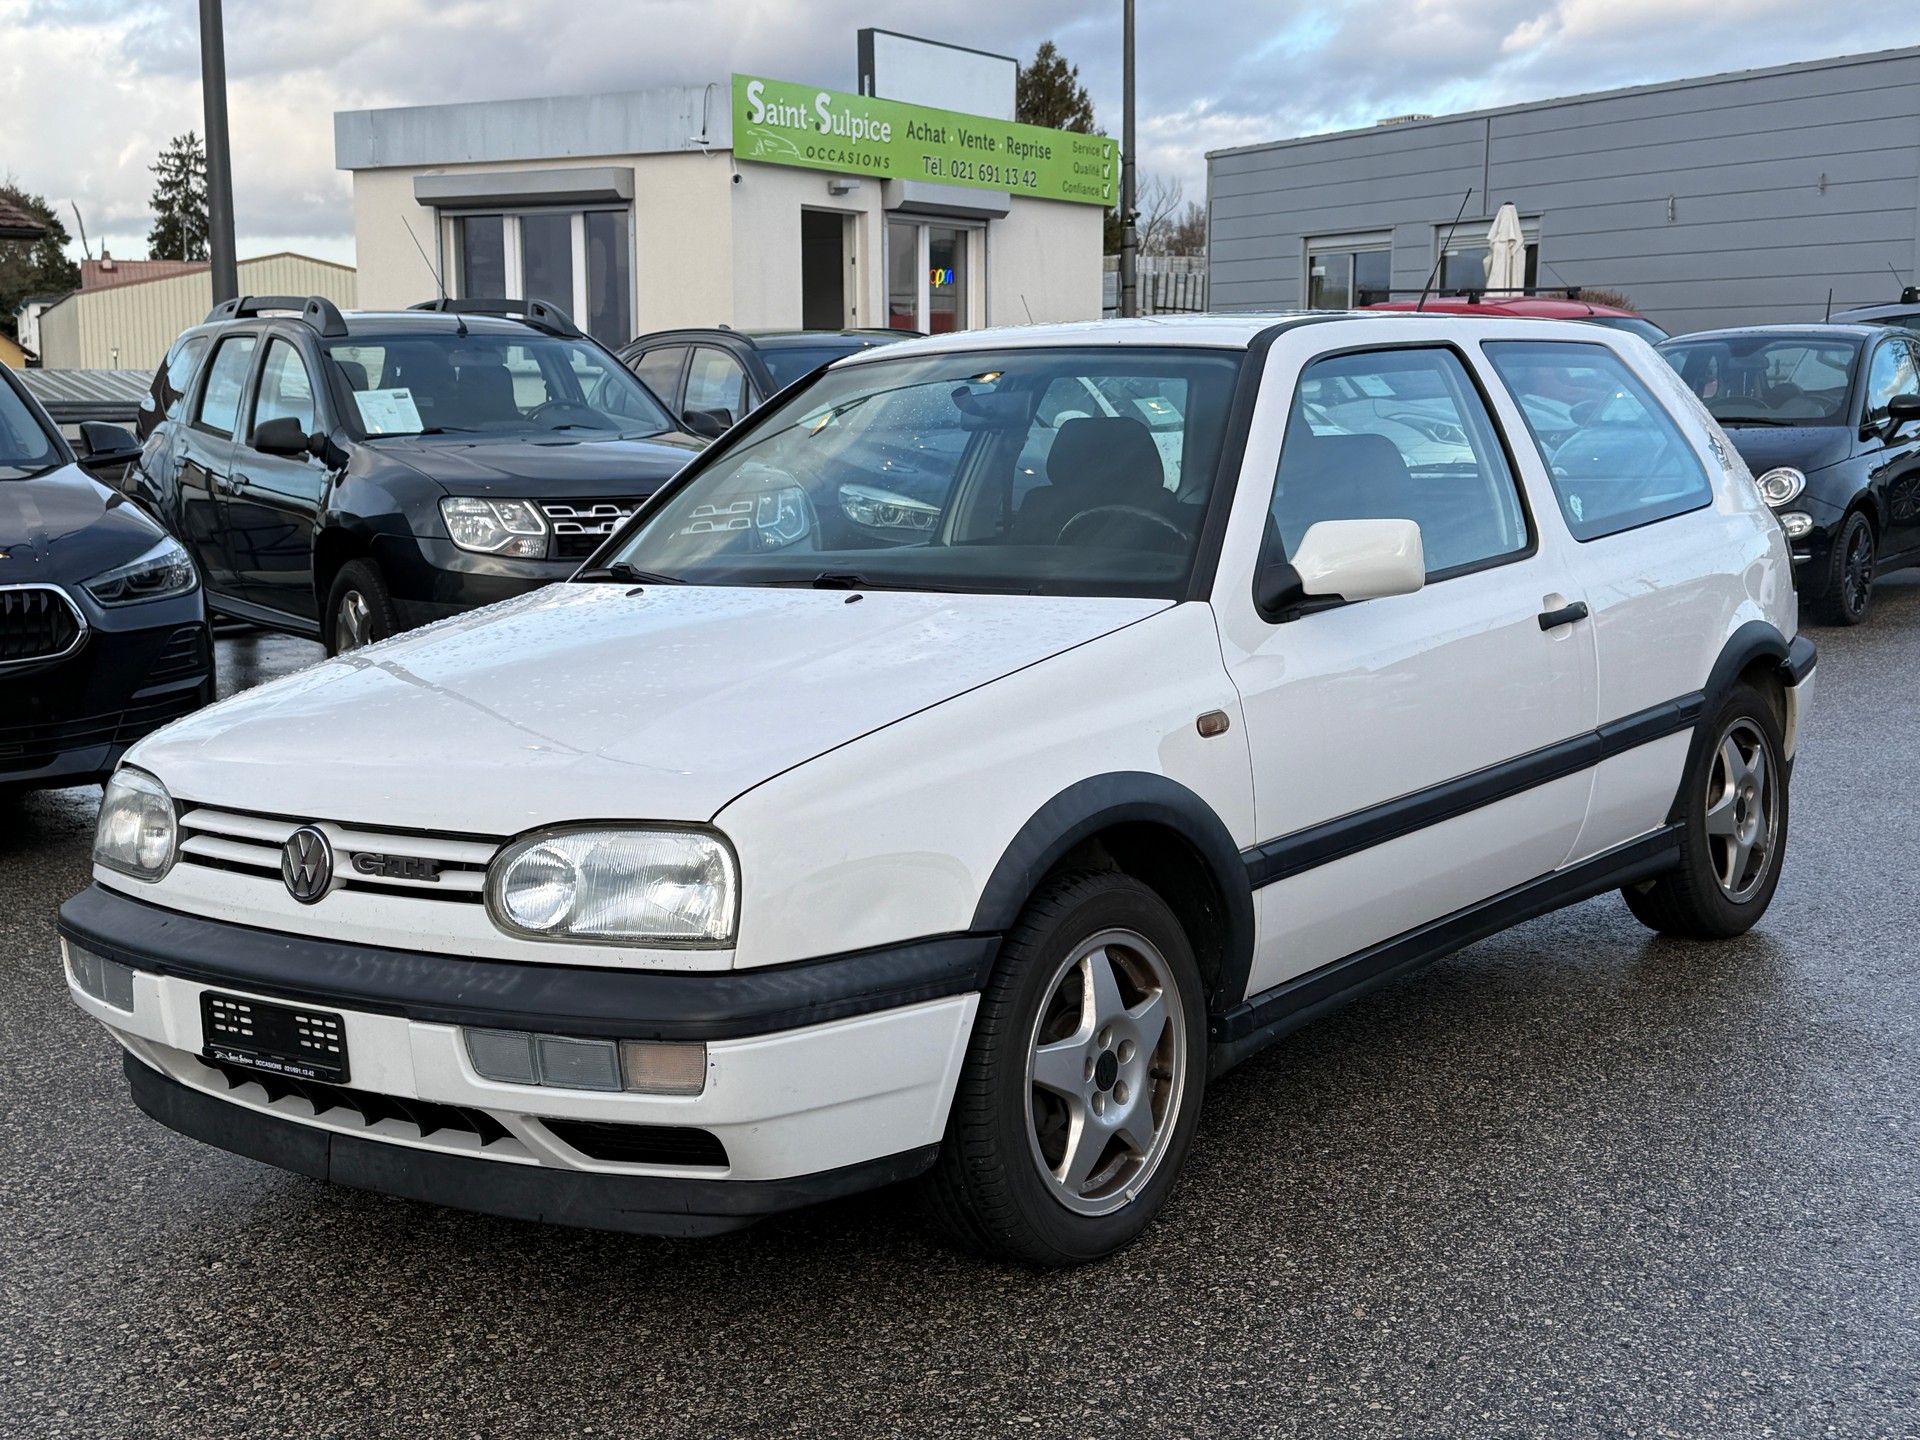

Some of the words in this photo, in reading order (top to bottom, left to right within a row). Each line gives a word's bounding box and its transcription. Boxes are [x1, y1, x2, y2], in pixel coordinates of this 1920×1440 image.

[747, 80, 891, 144] Saint-Sulpice
[906, 120, 946, 144] Achat
[958, 128, 995, 151] Vente
[1006, 136, 1052, 160] Reprise
[1072, 141, 1100, 156] Service
[806, 146, 890, 169] OCCASIONS
[1073, 161, 1100, 176] Qualité
[922, 155, 946, 176] Tél.
[951, 160, 974, 180] 021
[979, 164, 1000, 183] 691
[1005, 168, 1018, 185] 13
[1022, 170, 1037, 188] 42
[1062, 180, 1100, 196] Confiance
[352, 852, 440, 882] GTI
